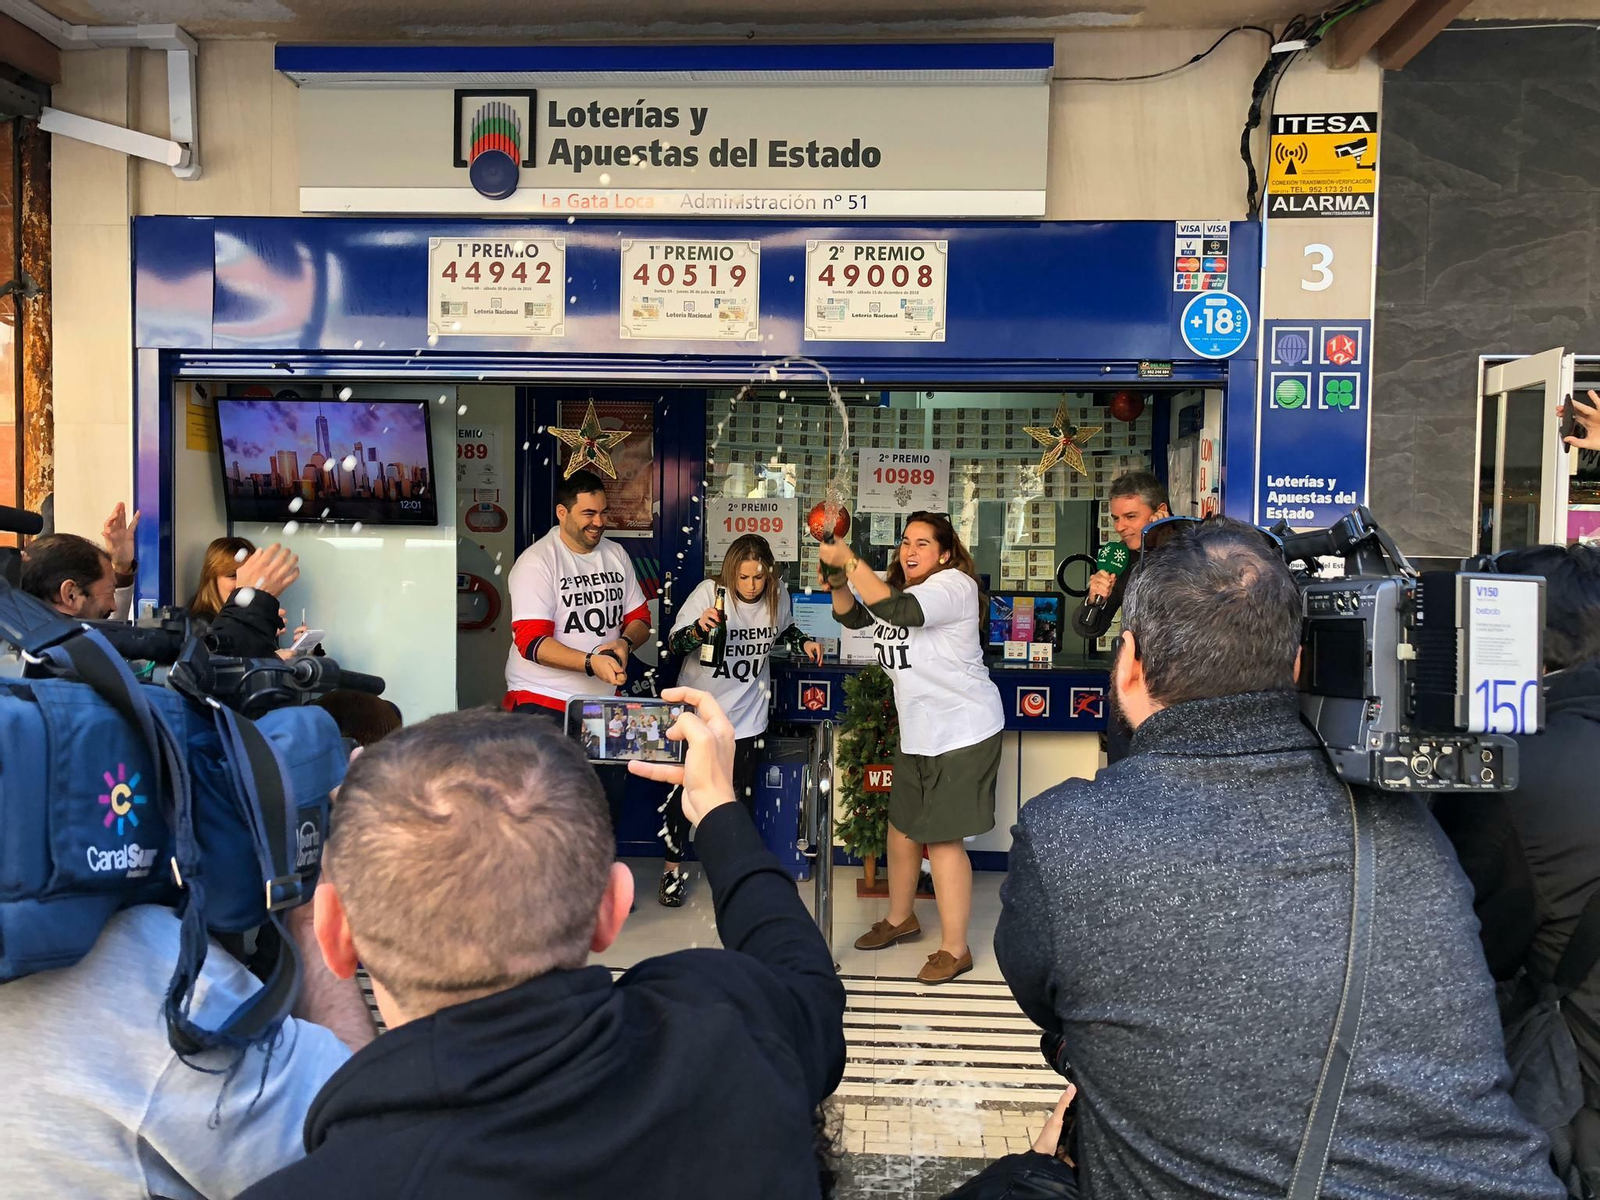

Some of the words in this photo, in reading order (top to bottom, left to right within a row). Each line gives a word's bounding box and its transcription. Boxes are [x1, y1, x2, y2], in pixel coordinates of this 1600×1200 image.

[548, 99, 680, 128] Loterías
[689, 105, 708, 136] y
[1278, 115, 1371, 134] ITESA
[548, 139, 699, 173] Apuestas
[708, 138, 757, 168] del
[768, 138, 882, 169] Estado
[542, 193, 561, 209] La
[567, 193, 609, 209] Gata
[615, 193, 654, 209] Loca
[680, 193, 816, 210] Administración
[823, 194, 842, 210] nº
[848, 194, 868, 210] 51
[1272, 195, 1370, 211] ALARMA
[1180, 225, 1201, 233] VISA
[1207, 225, 1227, 233] VISA
[472, 243, 539, 259] PREMIO
[664, 245, 734, 261] PREMIO
[828, 245, 845, 261] 2º
[854, 246, 925, 261] PREMIO
[1186, 241, 1193, 249] V
[441, 261, 551, 284] 44942
[633, 263, 747, 288] 40519
[818, 264, 933, 288] 49008
[1301, 243, 1334, 292] 3
[1190, 308, 1235, 335] +18
[1235, 309, 1243, 333] AÑOS
[458, 429, 483, 438] EMIO
[456, 443, 488, 460] 989
[892, 454, 930, 464] PREMIO
[873, 467, 935, 485] 10989
[1267, 474, 1325, 488] Loterías
[1327, 478, 1337, 491] y
[400, 500, 422, 510] 12:01
[1267, 491, 1333, 506] Apuestas
[1334, 491, 1356, 504] del
[741, 503, 778, 512] PREMIO
[1266, 506, 1315, 520] Estado
[723, 516, 784, 533] 10989
[561, 587, 624, 608] VENDIDO
[1475, 585, 1499, 598] V150
[1475, 607, 1501, 616] bebob
[712, 657, 767, 683] AQU
[86, 843, 158, 873] CanalSur
